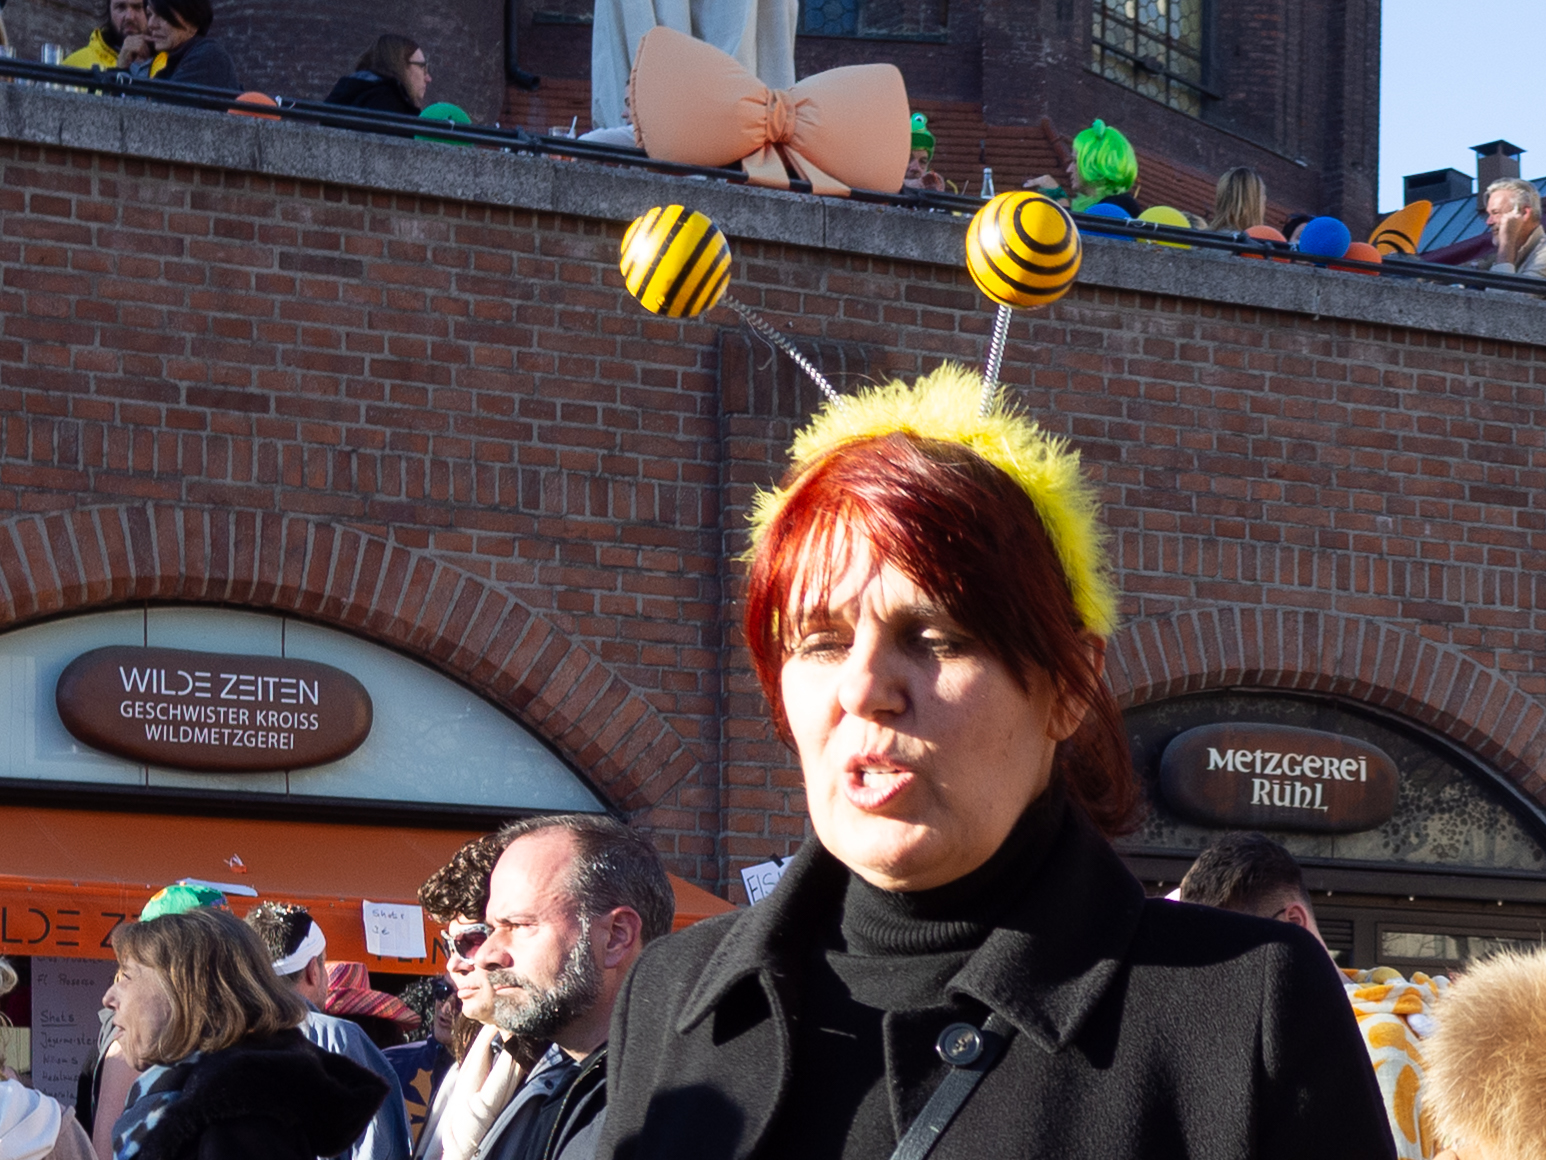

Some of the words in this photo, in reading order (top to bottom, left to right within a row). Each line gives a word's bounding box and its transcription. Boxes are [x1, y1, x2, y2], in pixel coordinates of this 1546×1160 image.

[119, 665, 212, 698] WILDE
[219, 672, 319, 706] ZEITEN
[119, 700, 249, 726] GESCHWISTER
[256, 709, 319, 731] KROISS
[145, 723, 294, 750] WILDMETZGEREI
